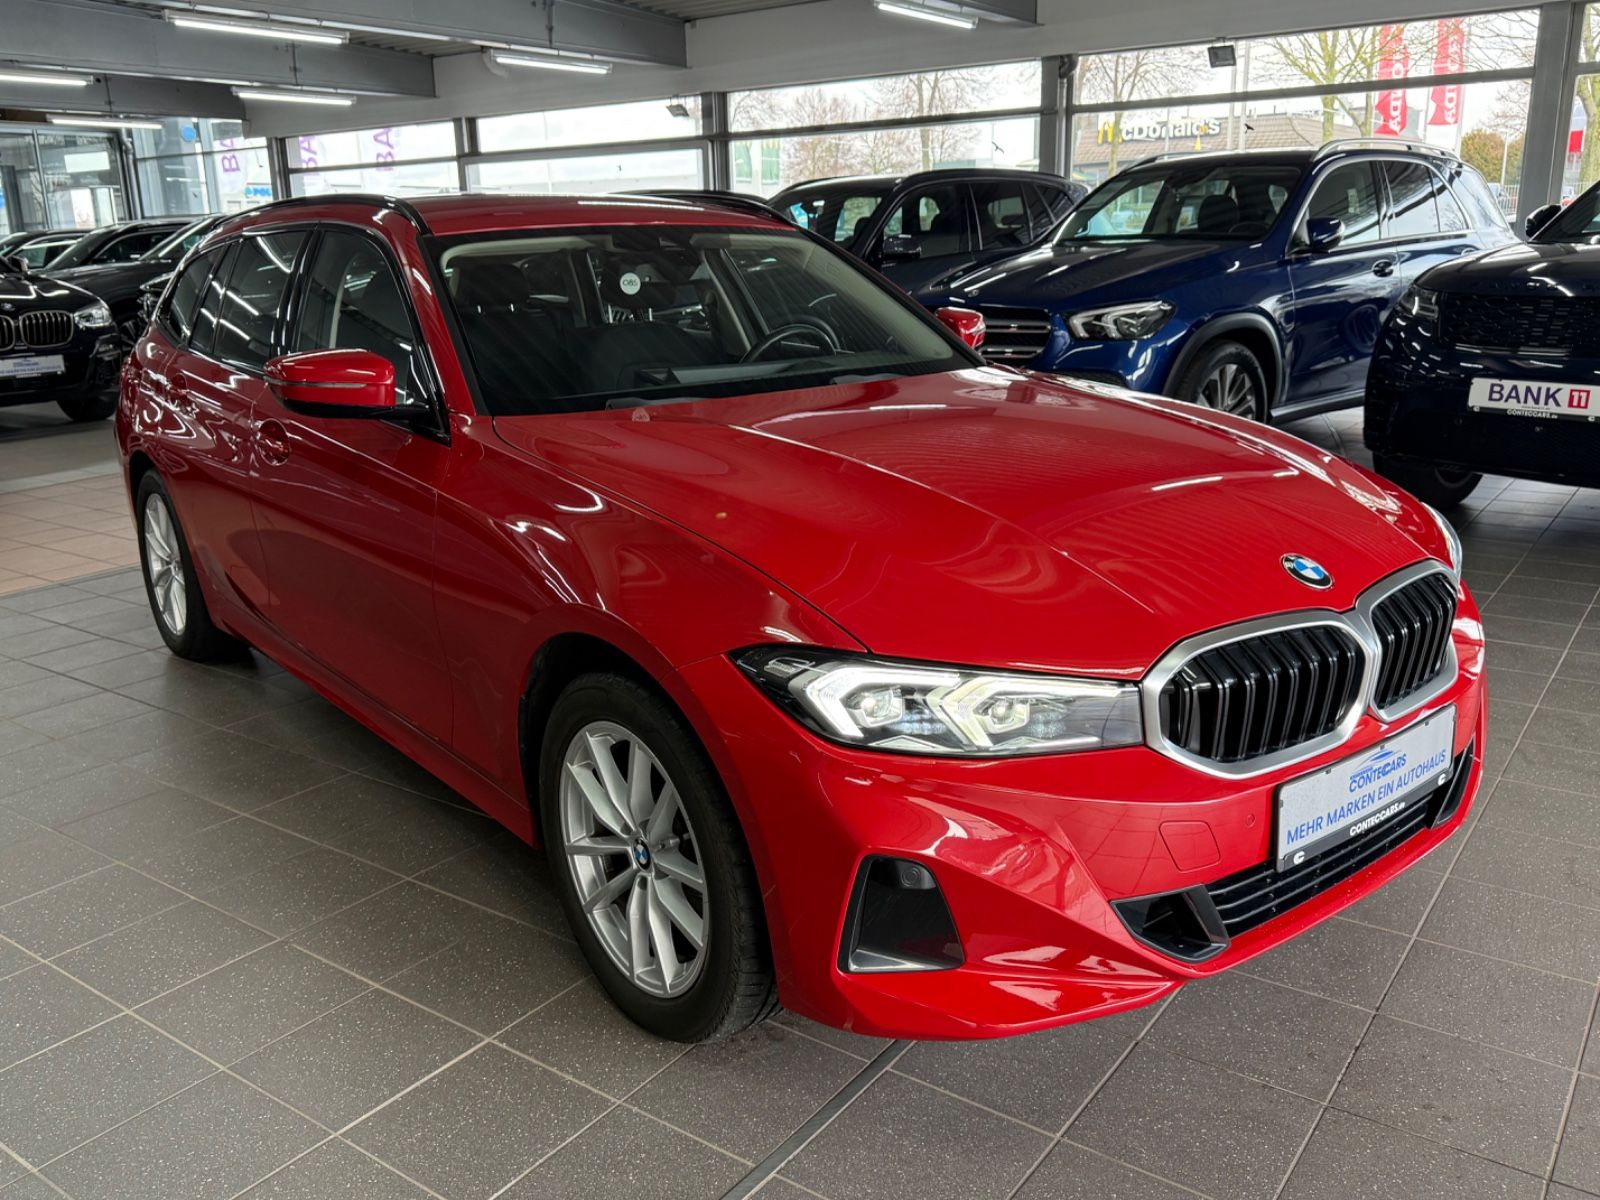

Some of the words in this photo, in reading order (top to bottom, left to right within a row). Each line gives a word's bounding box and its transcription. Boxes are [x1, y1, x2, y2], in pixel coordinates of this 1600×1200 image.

[1097, 119, 1220, 144] McDonald's
[1488, 383, 1563, 407] BANK
[1570, 389, 1589, 408] 11
[1287, 816, 1323, 845] MEHR
[1326, 790, 1376, 827] MARKEN
[1378, 780, 1395, 800] EIN
[1396, 750, 1446, 789] AUTOHAUS
